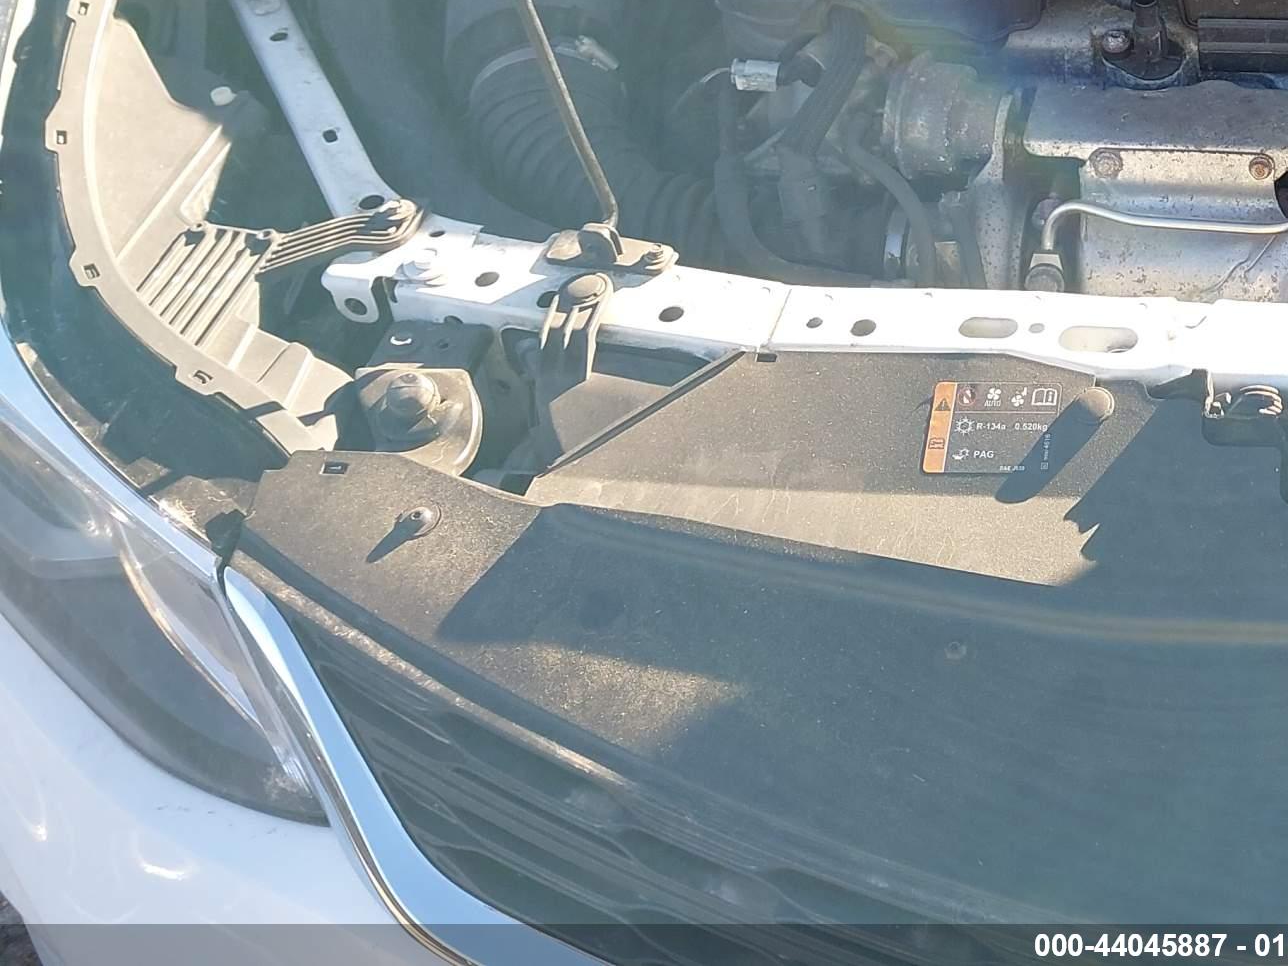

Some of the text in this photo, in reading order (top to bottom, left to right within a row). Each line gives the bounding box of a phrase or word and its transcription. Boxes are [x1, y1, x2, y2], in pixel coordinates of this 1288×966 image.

[976, 422, 1048, 433] R-134a 0.520kg
[973, 450, 995, 459] PAG
